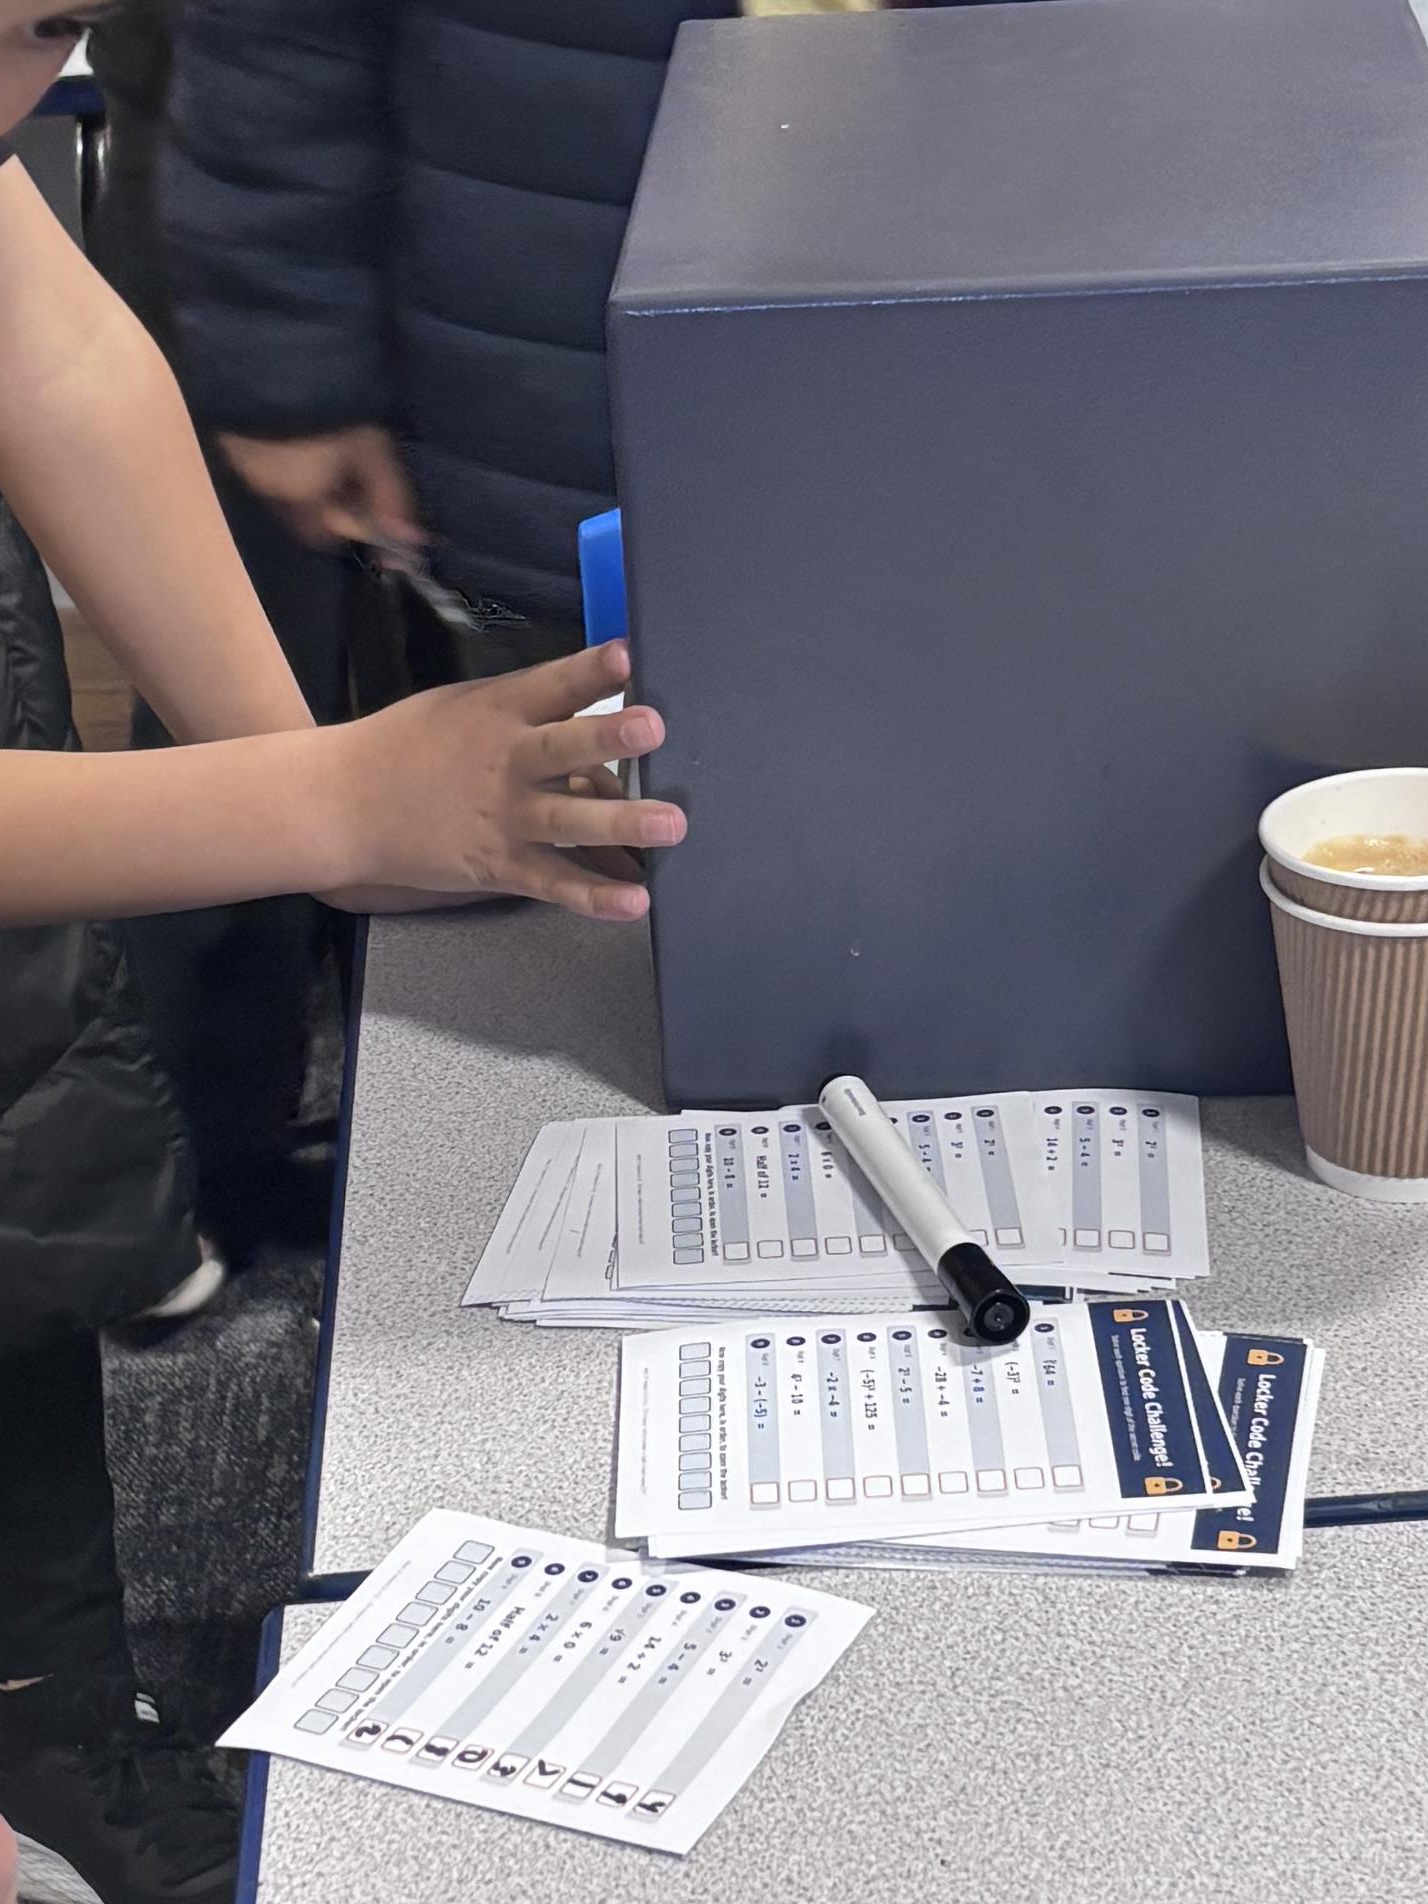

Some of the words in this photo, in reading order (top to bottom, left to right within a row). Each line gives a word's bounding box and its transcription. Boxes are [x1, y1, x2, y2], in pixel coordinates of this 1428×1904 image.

[1130, 1327, 1151, 1366] Locker
[1138, 1368, 1160, 1400] Code
[1253, 1373, 1277, 1416] Locker
[1145, 1402, 1175, 1468] Challenge!
[1247, 1418, 1270, 1450] Code
[1235, 1451, 1265, 1523] Challe!
[471, 1598, 492, 1611] 10
[498, 1606, 527, 1627] Half
[543, 1612, 561, 1622] 2
[452, 1622, 470, 1632] 8
[485, 1629, 507, 1642] of
[472, 1642, 494, 1657] 12
[681, 1642, 698, 1651] 5
[624, 1661, 642, 1671] 2
[664, 1662, 681, 1671] 4
